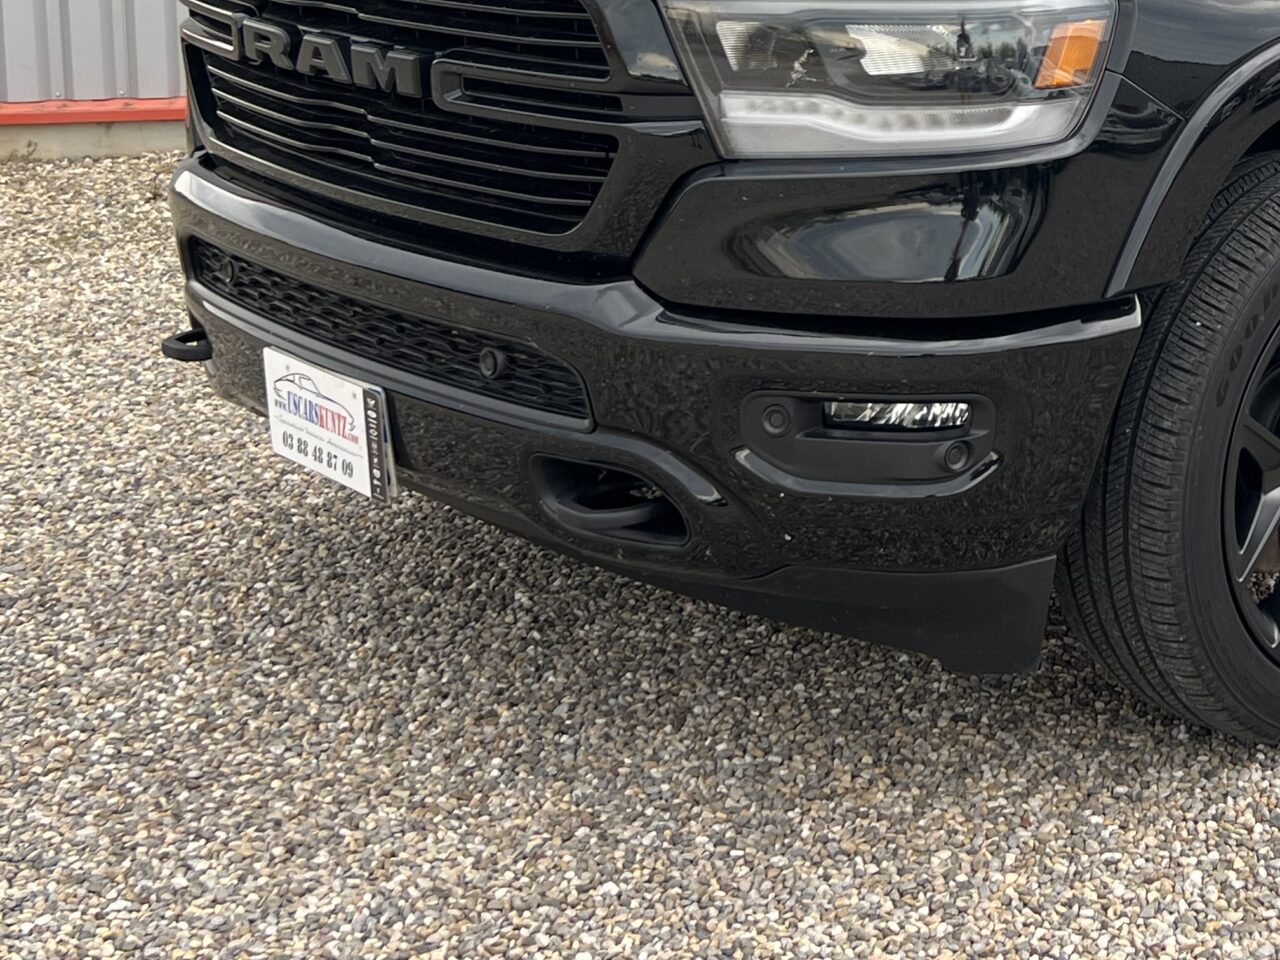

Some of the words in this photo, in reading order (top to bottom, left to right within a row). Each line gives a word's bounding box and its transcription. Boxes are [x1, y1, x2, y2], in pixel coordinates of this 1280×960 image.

[242, 17, 422, 98] RAM
[282, 429, 294, 450] 03
[341, 458, 354, 478] 09
